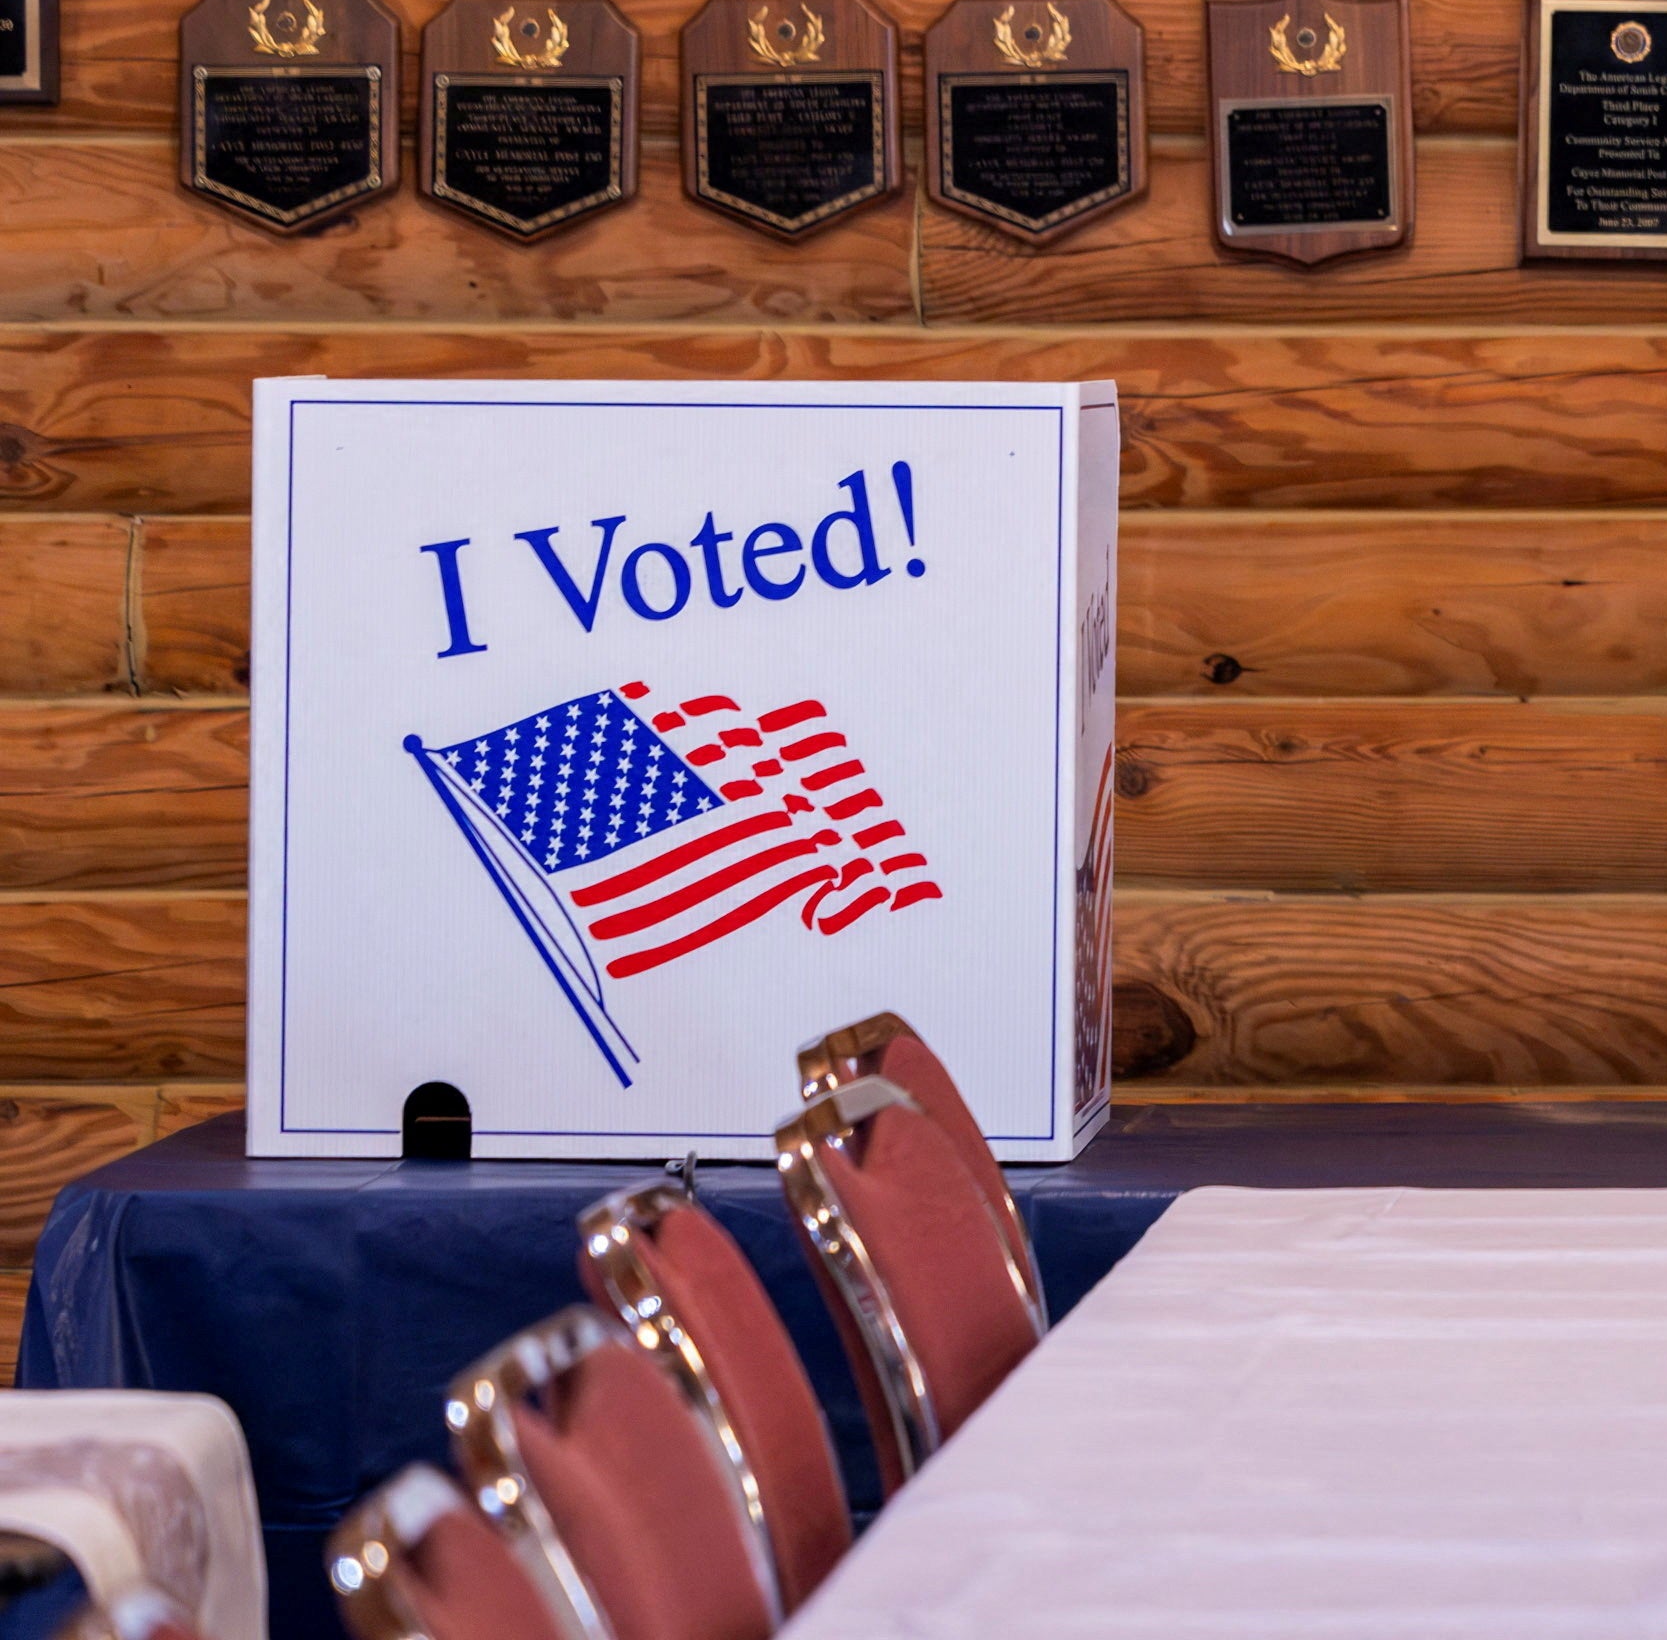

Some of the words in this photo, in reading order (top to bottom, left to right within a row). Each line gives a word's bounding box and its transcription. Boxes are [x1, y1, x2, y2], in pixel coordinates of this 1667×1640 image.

[1559, 83, 1616, 95] Department
[1617, 85, 1628, 94] of
[1630, 86, 1658, 95] South
[420, 538, 488, 659] I
[513, 460, 927, 633] Voted!
